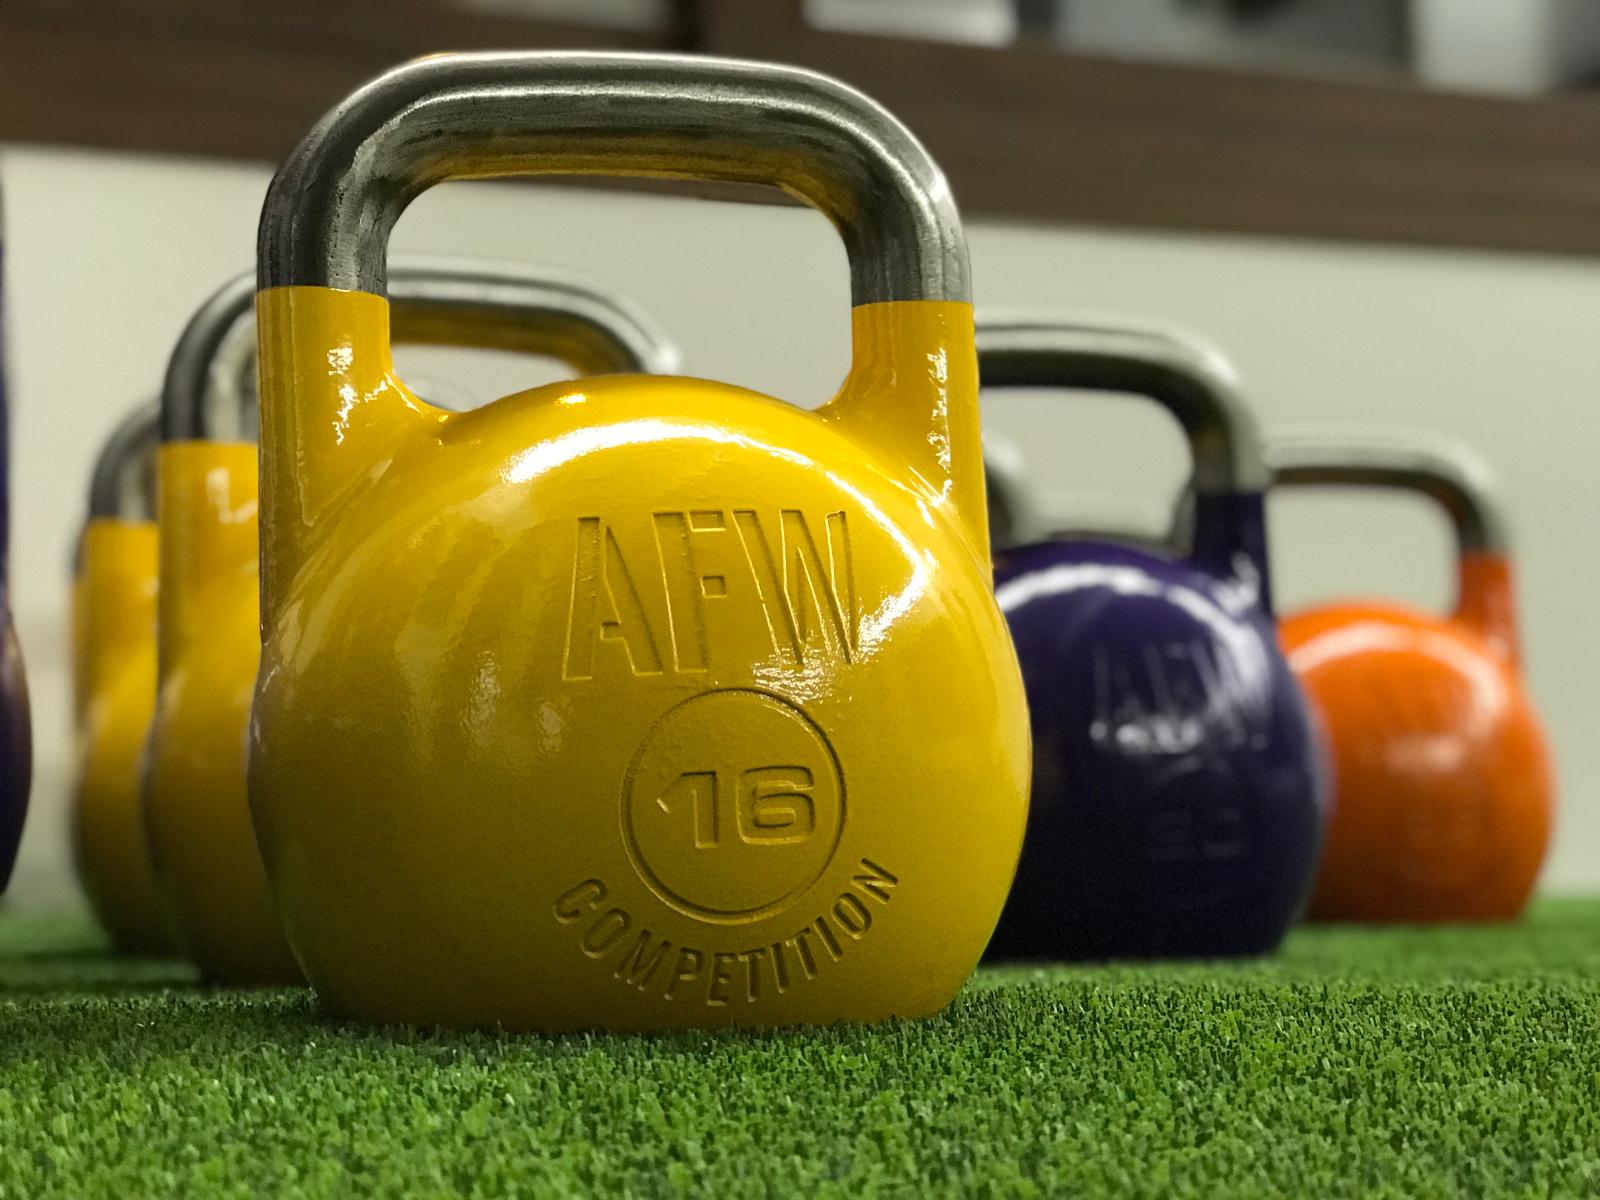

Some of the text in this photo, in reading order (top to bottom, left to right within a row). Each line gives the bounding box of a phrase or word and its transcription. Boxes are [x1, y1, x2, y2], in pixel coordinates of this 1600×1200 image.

[562, 509, 857, 681] AFW
[656, 765, 816, 849] 16
[553, 857, 899, 1007] COMPETITION
